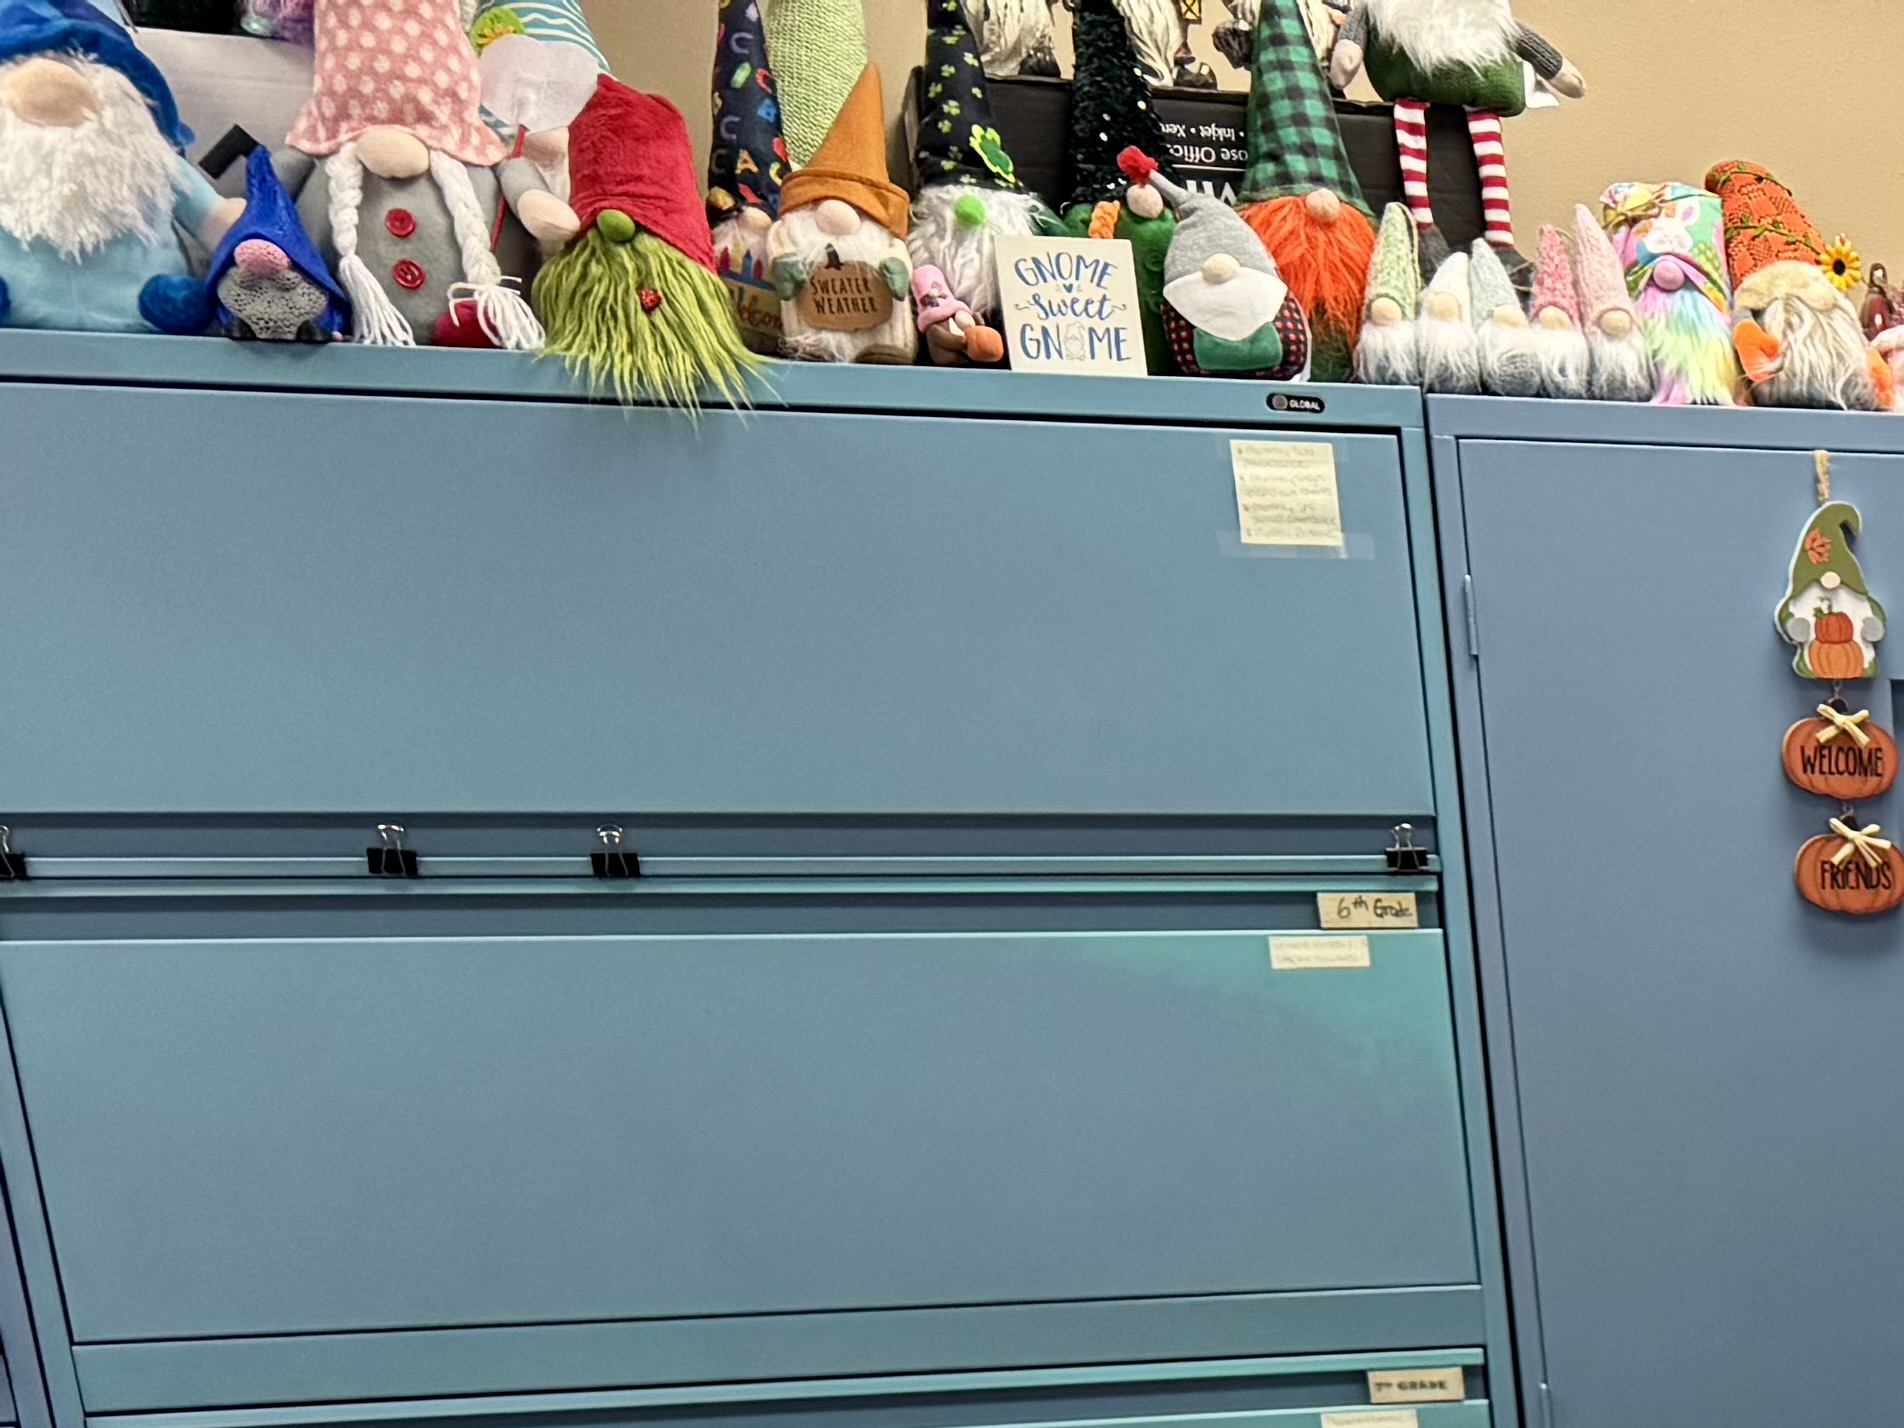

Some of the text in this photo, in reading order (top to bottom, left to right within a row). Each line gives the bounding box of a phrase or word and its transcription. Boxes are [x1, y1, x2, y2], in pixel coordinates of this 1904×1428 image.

[809, 272, 871, 297] SWEATER
[1014, 251, 1117, 291] GNOME
[811, 293, 878, 317] WEATHER
[1032, 290, 1111, 322] Sweet
[1799, 743, 1884, 779] WELCOME
[1819, 858, 1893, 891] FRIENDS
[1373, 897, 1413, 919] Grade
[1397, 1380, 1448, 1392] GRADE
